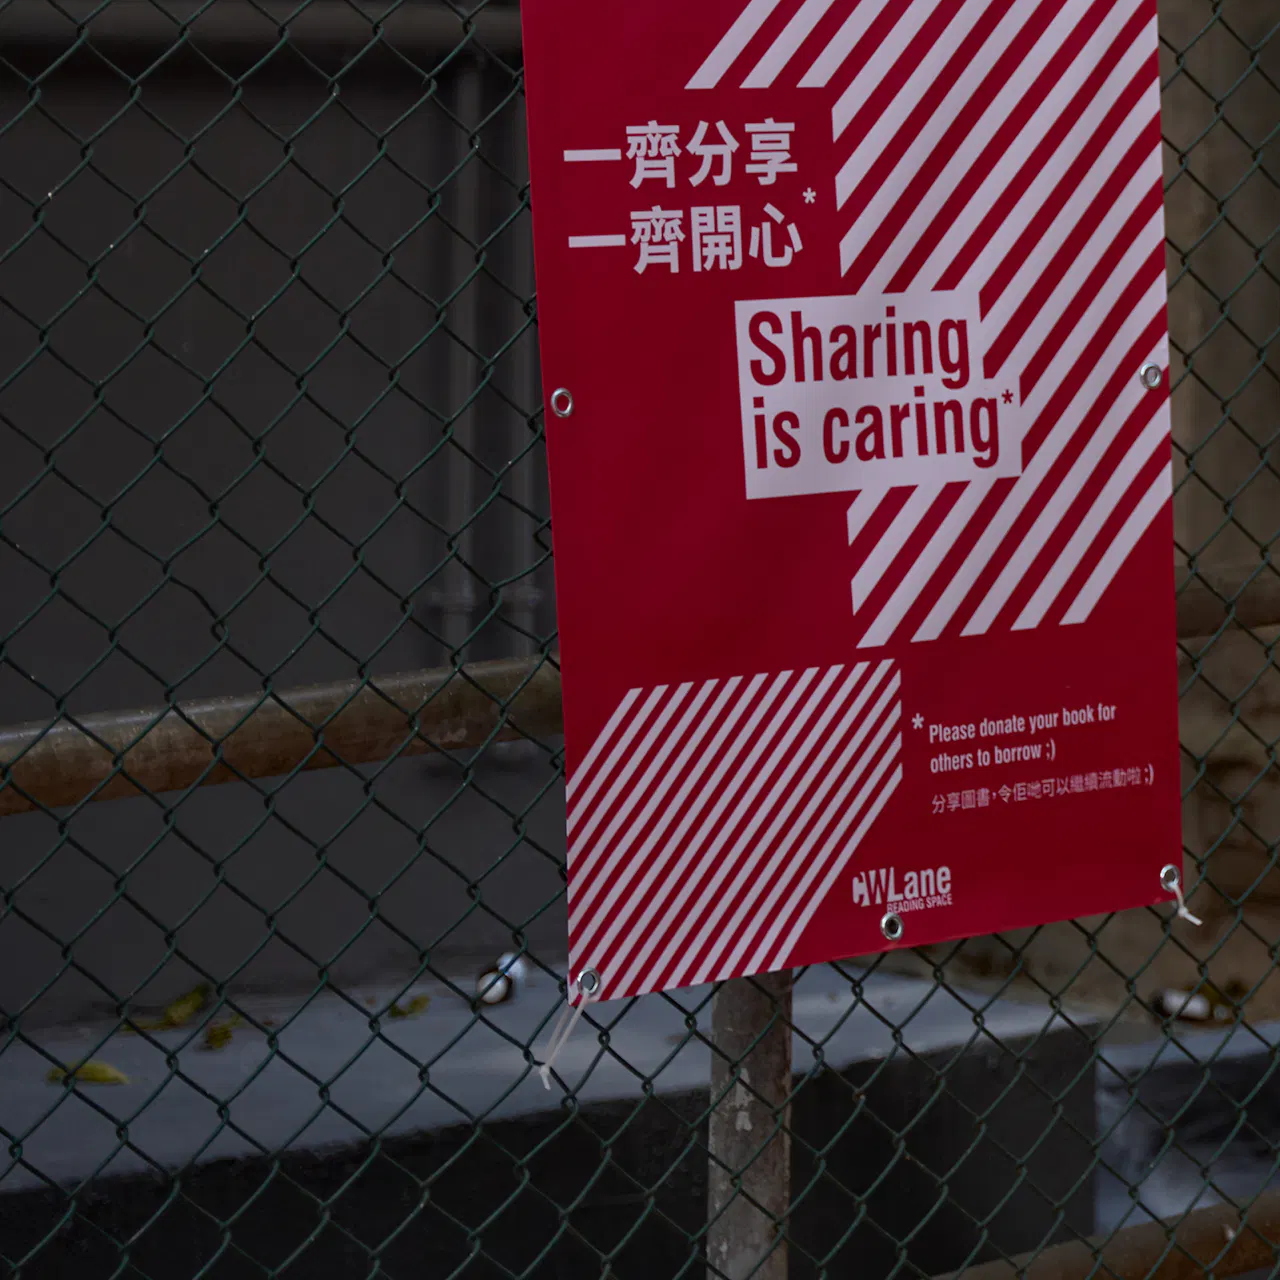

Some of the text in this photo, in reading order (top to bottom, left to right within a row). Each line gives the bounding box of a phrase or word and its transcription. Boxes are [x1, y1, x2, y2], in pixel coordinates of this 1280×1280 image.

[563, 117, 798, 190] 一齊分享
[748, 305, 970, 390] Sharing
[752, 395, 802, 469] is
[929, 702, 1117, 744] Please donate your book for
[930, 738, 1057, 774] others to borrow ;)
[852, 865, 952, 908] CWLane
[886, 893, 953, 914] READING SPACE
